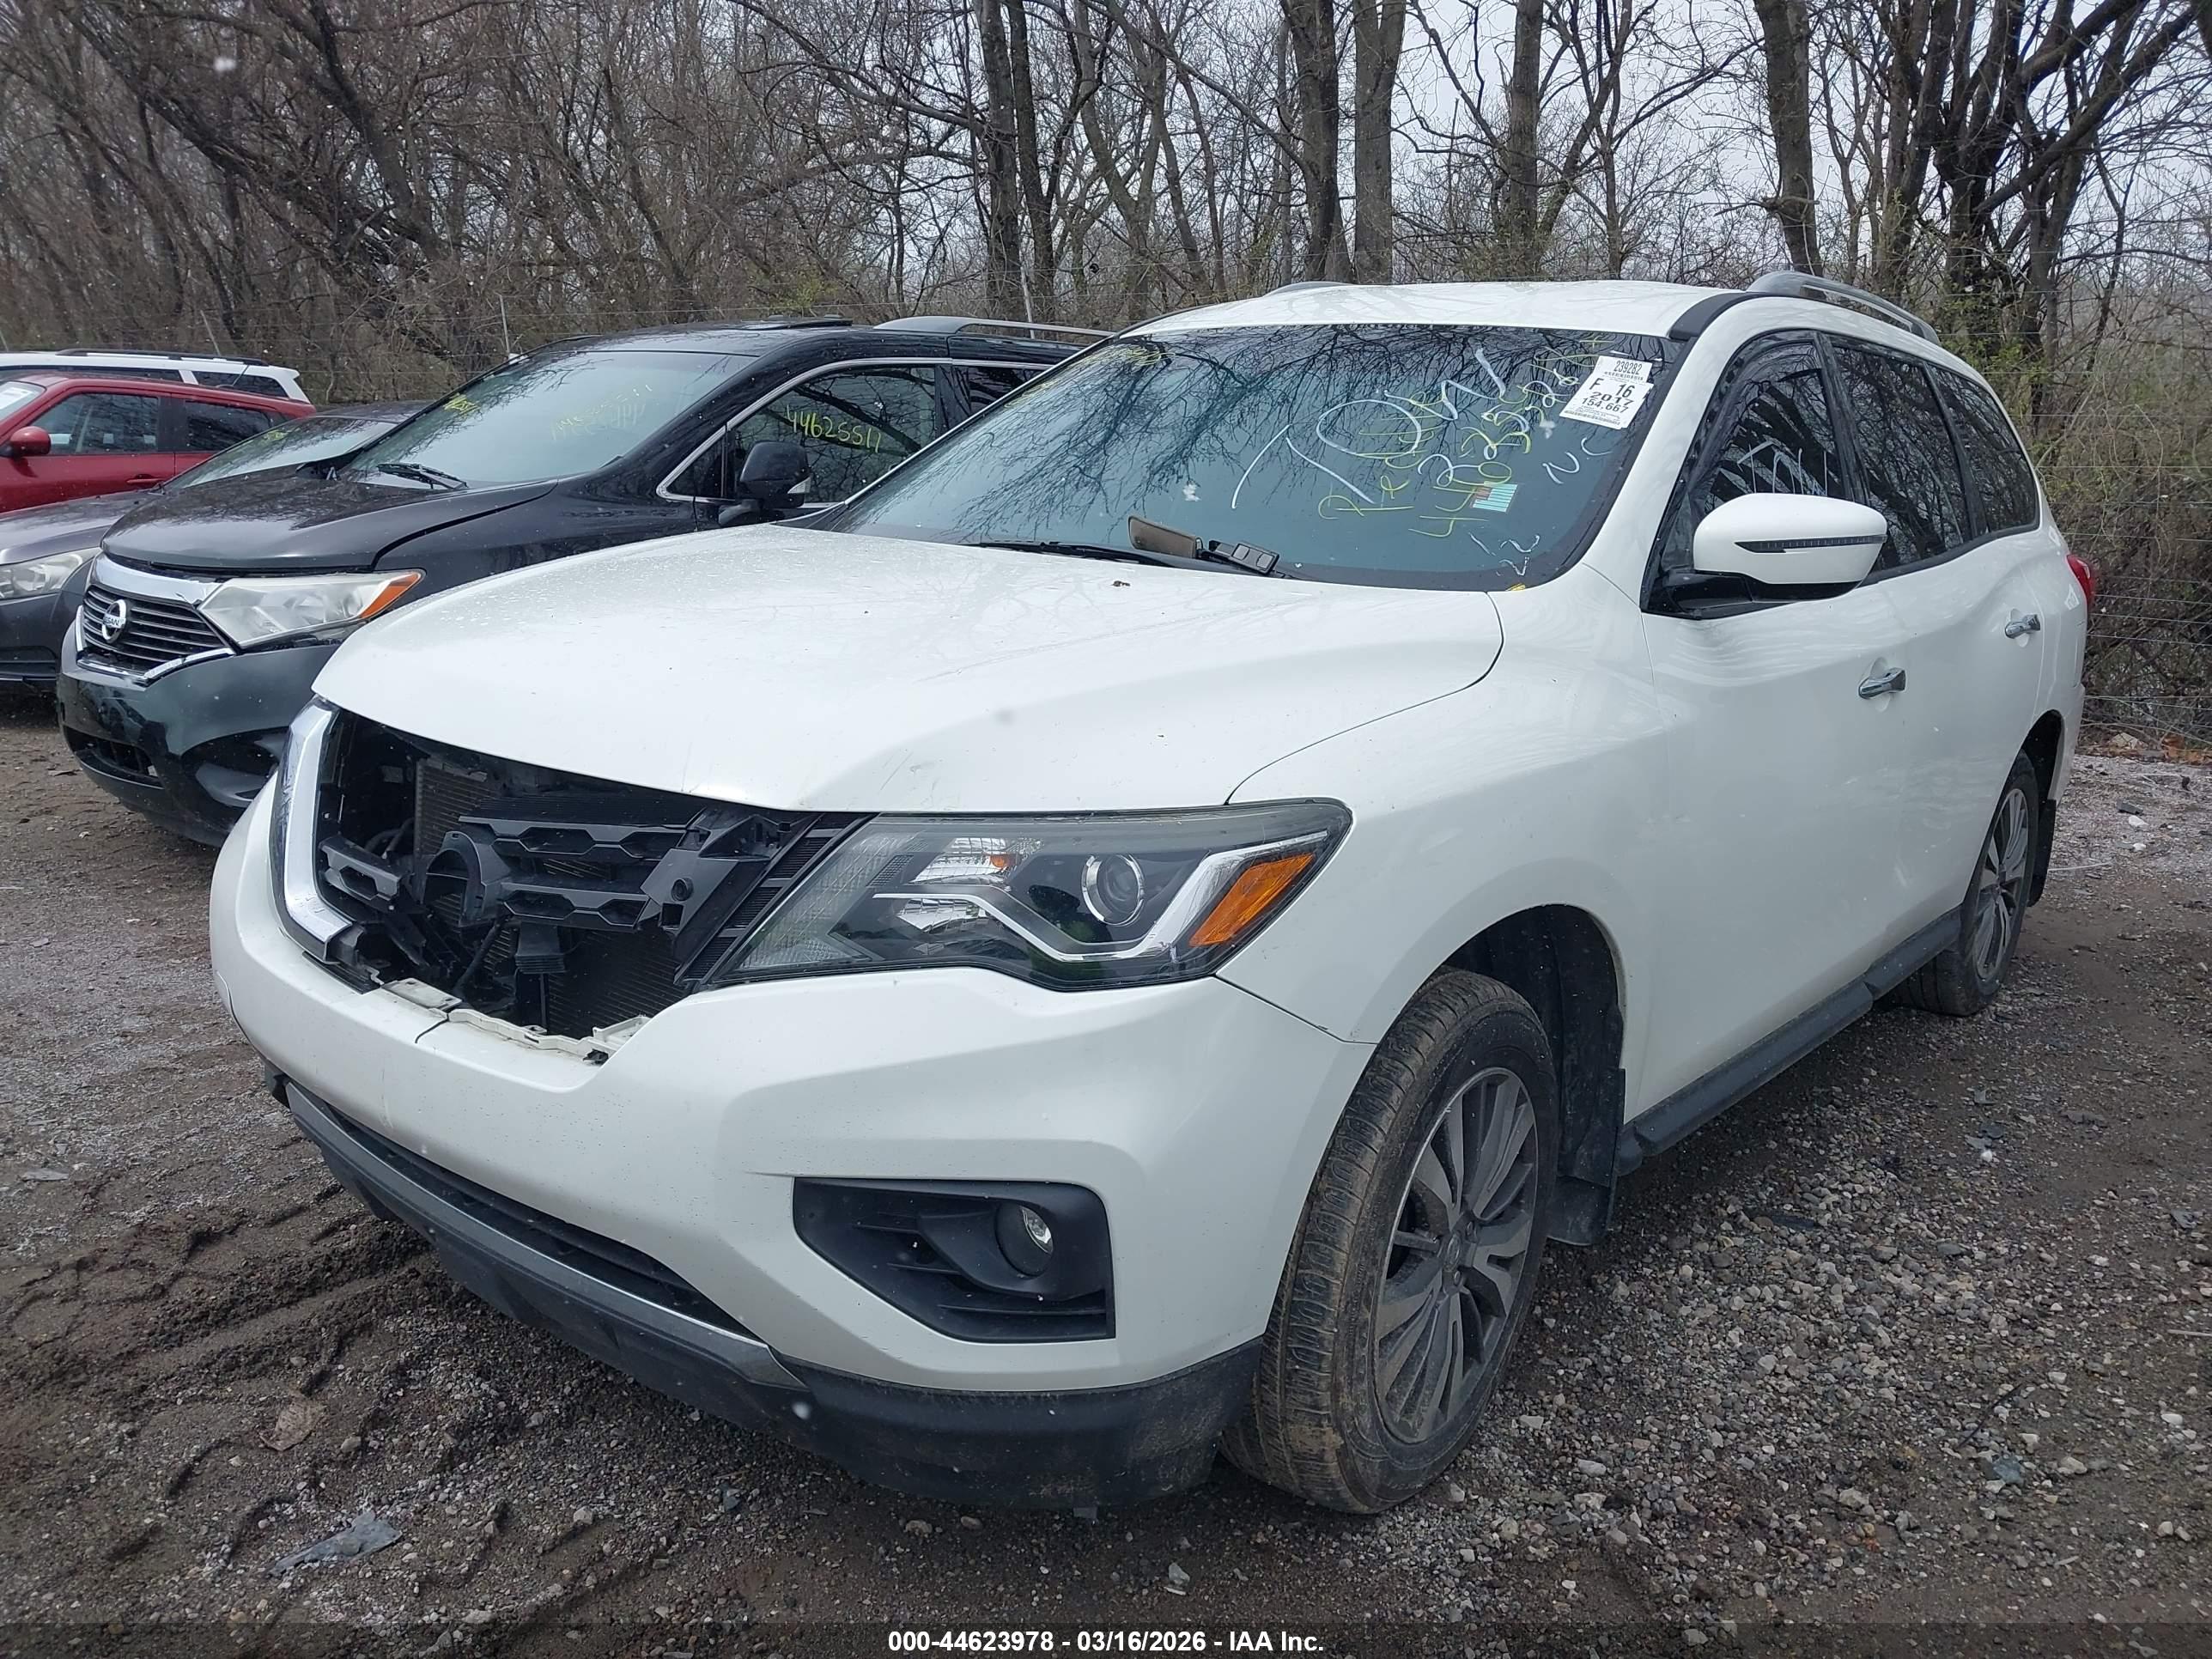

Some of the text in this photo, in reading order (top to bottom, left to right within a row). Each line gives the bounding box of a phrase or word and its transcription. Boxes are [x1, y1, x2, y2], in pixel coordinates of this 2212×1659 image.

[1613, 360, 1643, 375] 239282
[1589, 377, 1604, 390] F
[1615, 383, 1635, 398] 16
[1589, 392, 1634, 406] 2017
[787, 404, 881, 453] 44625511
